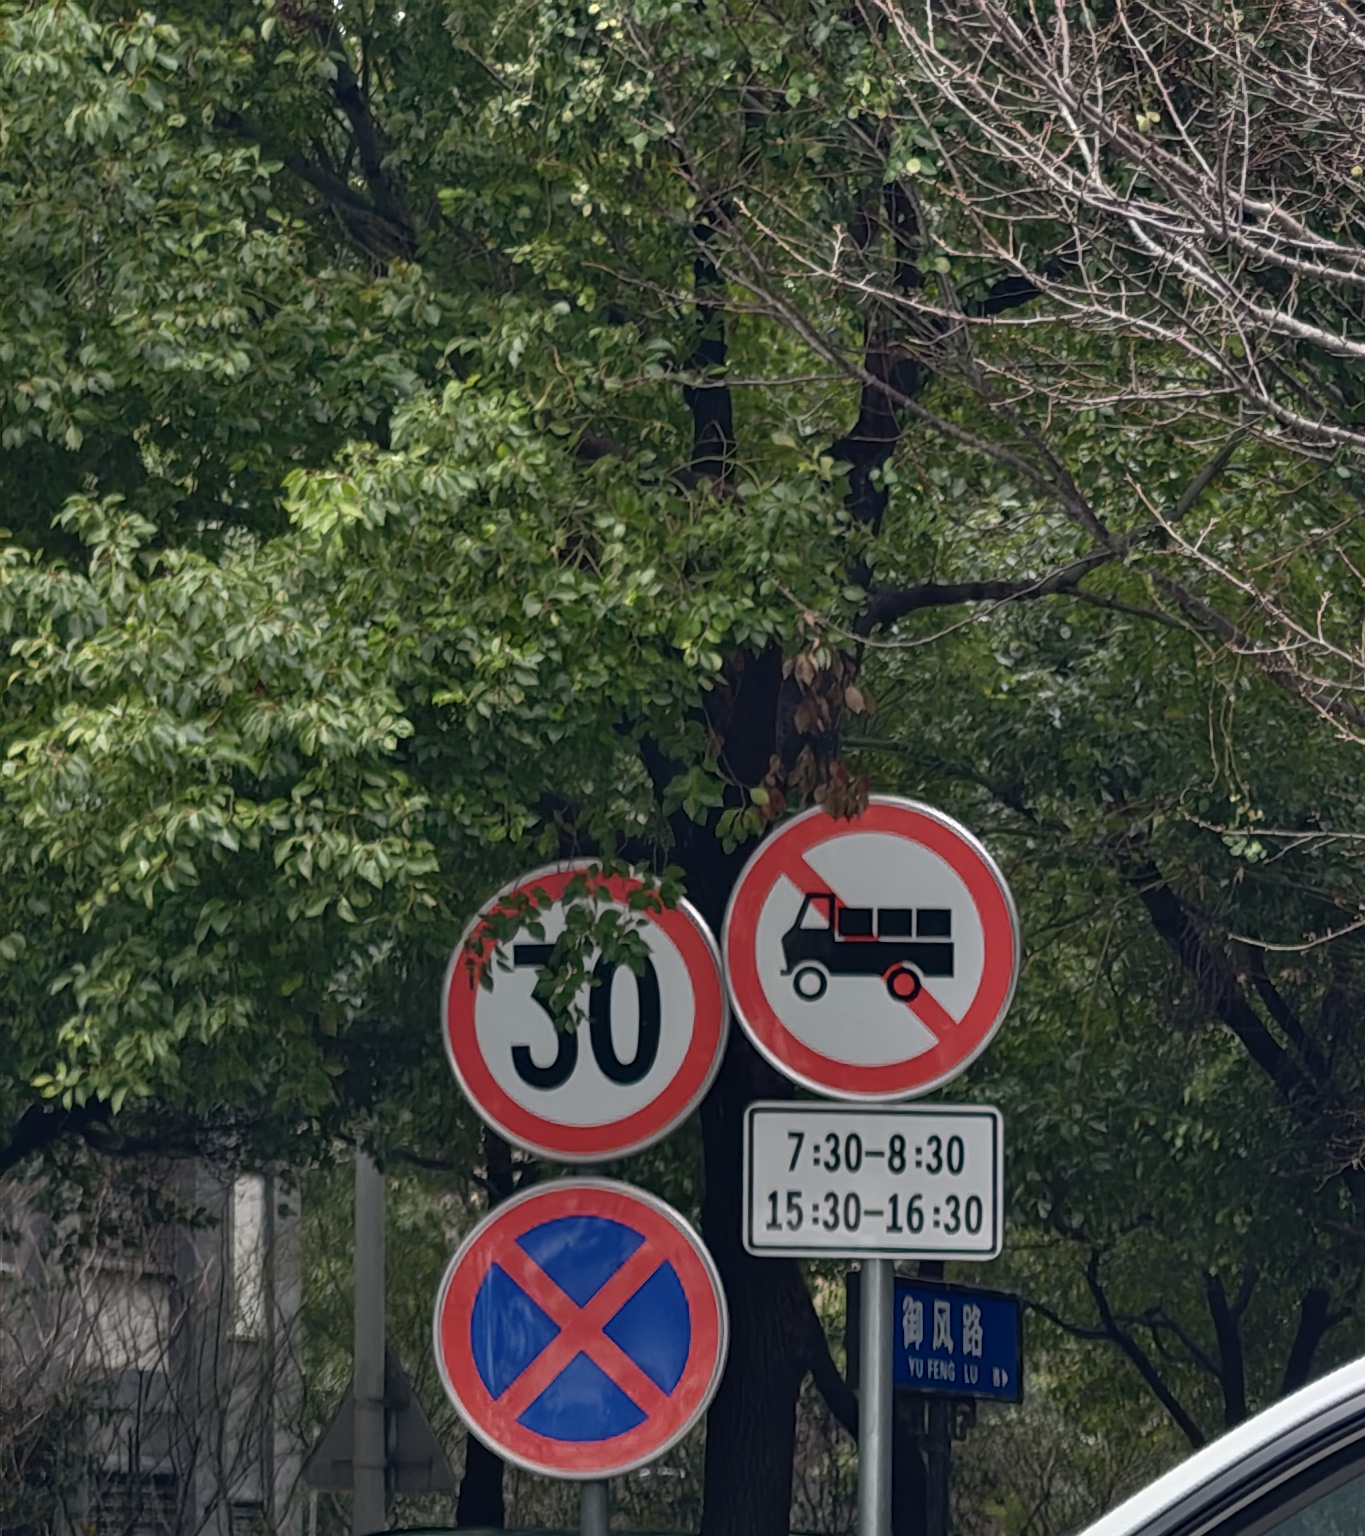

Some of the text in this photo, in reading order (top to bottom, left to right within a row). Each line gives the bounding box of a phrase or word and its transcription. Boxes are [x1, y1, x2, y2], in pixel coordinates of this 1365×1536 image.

[511, 940, 661, 1091] 30
[902, 1294, 983, 1358] 御风路
[908, 1356, 924, 1379] YU
[927, 1358, 956, 1382] FENG
[963, 1363, 979, 1385] LU
